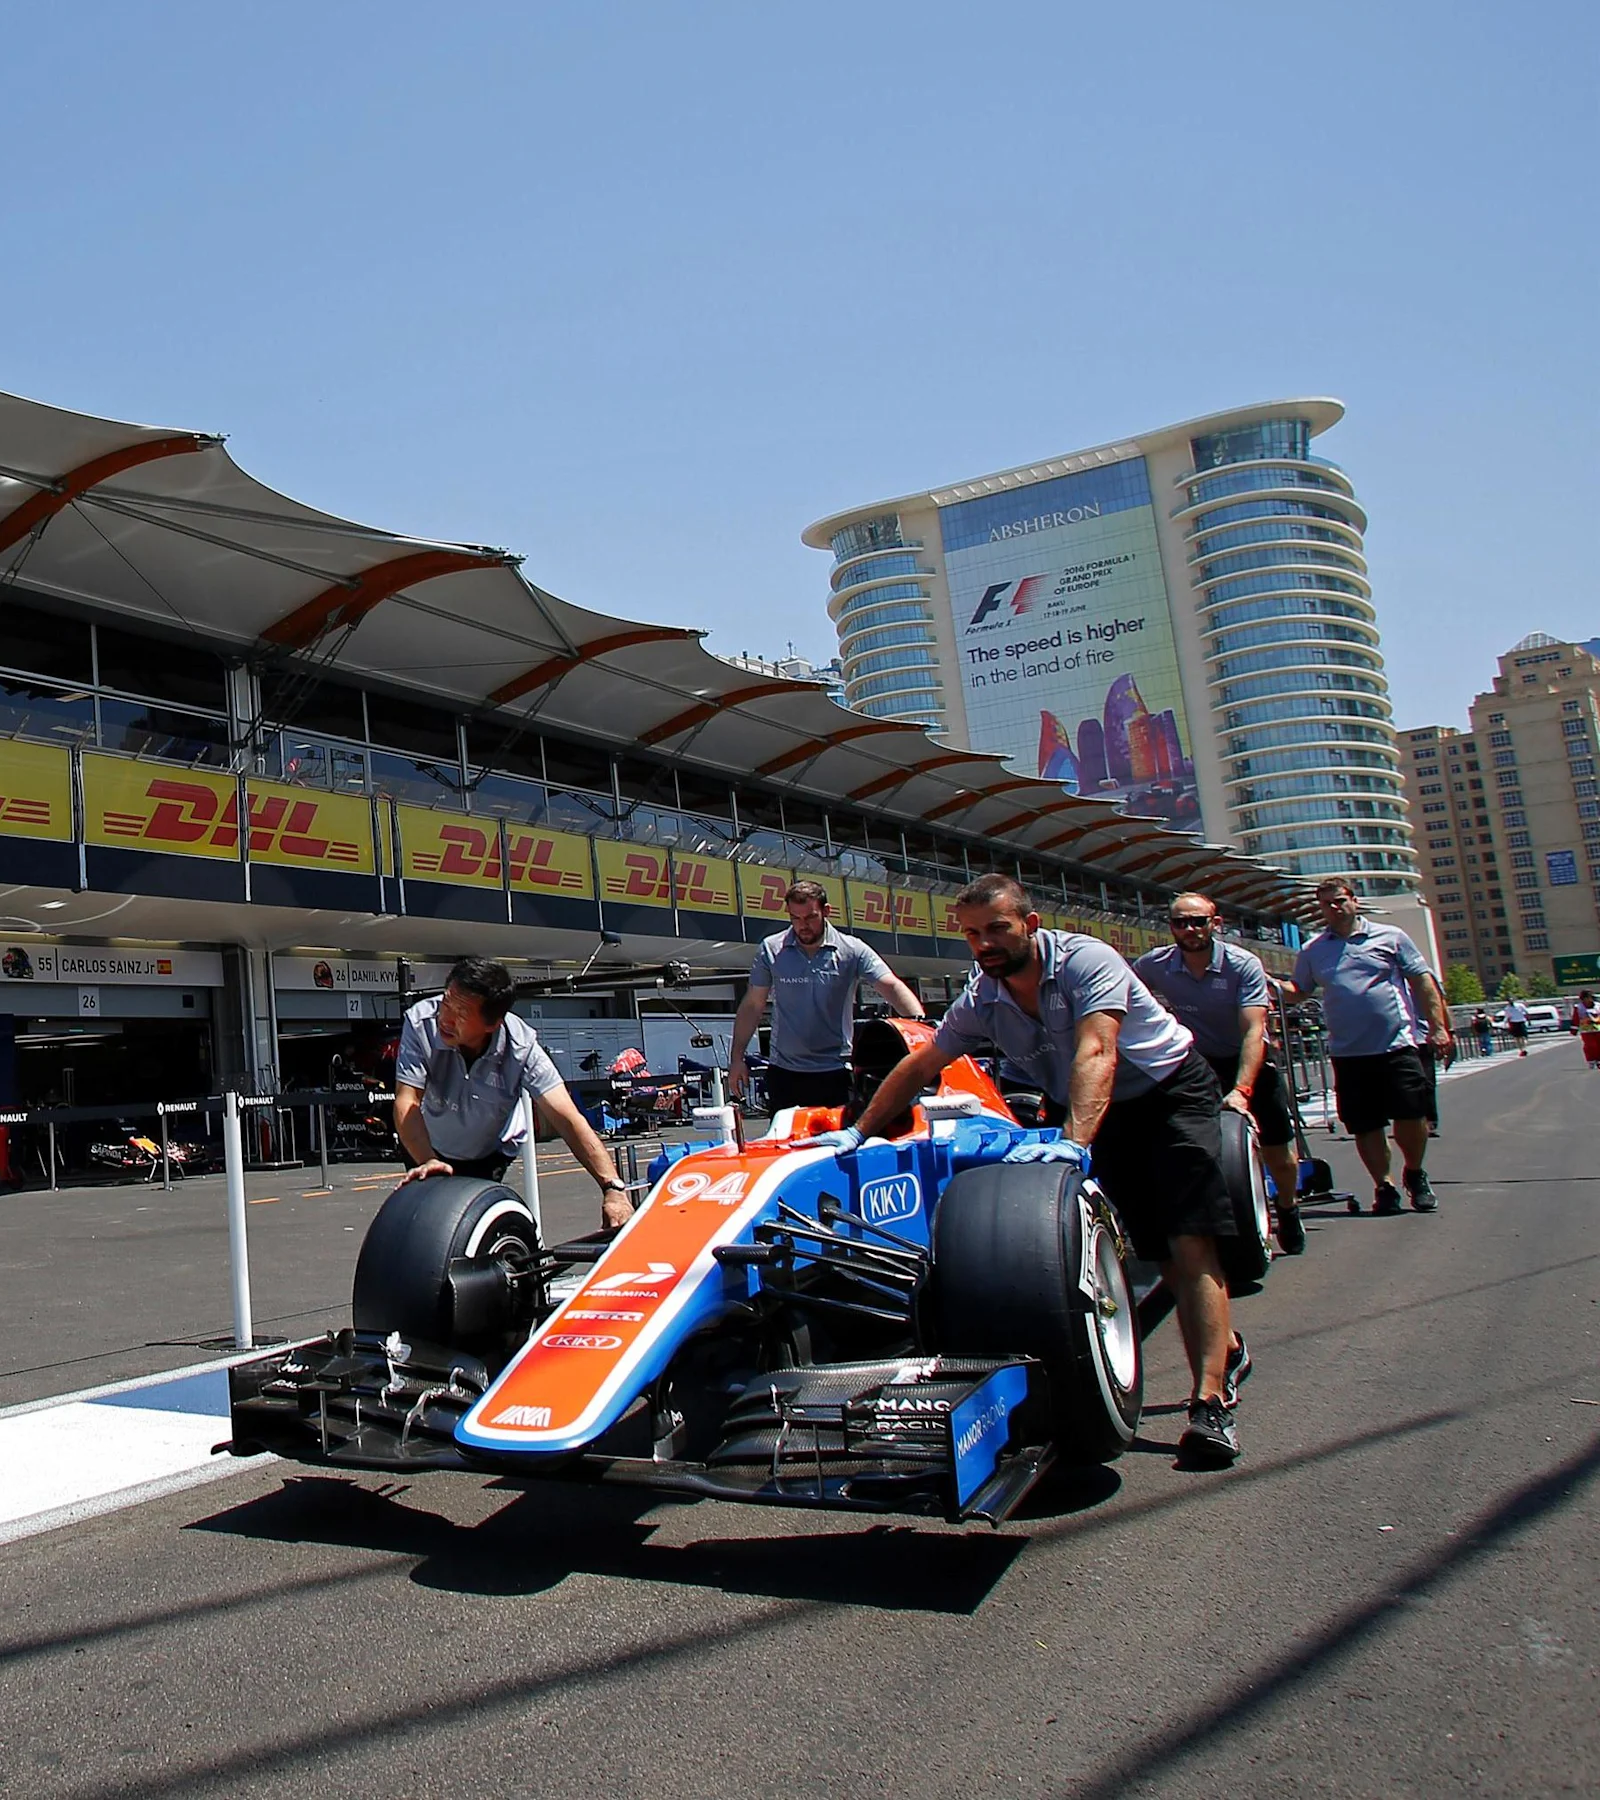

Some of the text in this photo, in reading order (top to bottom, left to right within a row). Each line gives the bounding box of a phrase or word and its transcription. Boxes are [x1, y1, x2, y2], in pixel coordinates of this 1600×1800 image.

[989, 500, 1101, 543] ABSHERON
[1064, 553, 1137, 576] 2016 FORMULA 1
[1059, 567, 1113, 586] GRAND PRIX
[1054, 579, 1100, 596] OF EUROPE
[1047, 600, 1066, 609] BAKU
[1070, 604, 1086, 614] JUNE
[964, 620, 1005, 636] Formula
[967, 617, 1146, 664] The speed is higher
[971, 649, 1115, 688] in the land of fire
[142, 778, 329, 858] DHL
[438, 824, 563, 885] DHL
[624, 853, 714, 903] DHL
[863, 890, 918, 928] DHL
[38, 957, 155, 975] 55 CARLOS SAINZ Jr
[336, 969, 400, 984] 26 DANIIL KVYA
[83, 995, 96, 1009] 26
[349, 1000, 360, 1012] 27
[335, 1083, 365, 1091] SAPINDA
[165, 1101, 198, 1114] RENAULT
[245, 1096, 274, 1107] RENAULT
[924, 1102, 972, 1112] REBELLION
[337, 1123, 366, 1132] SAPINDA
[662, 1171, 750, 1207] 94
[868, 1181, 907, 1219] KIKY
[581, 1288, 660, 1299] PERTAMINA
[563, 1309, 646, 1322] PIRELLI
[556, 1335, 611, 1348] KIKY
[876, 1397, 950, 1412] MANO
[875, 1420, 946, 1430] RACIN
[956, 1396, 1007, 1460] MANOR RACING
